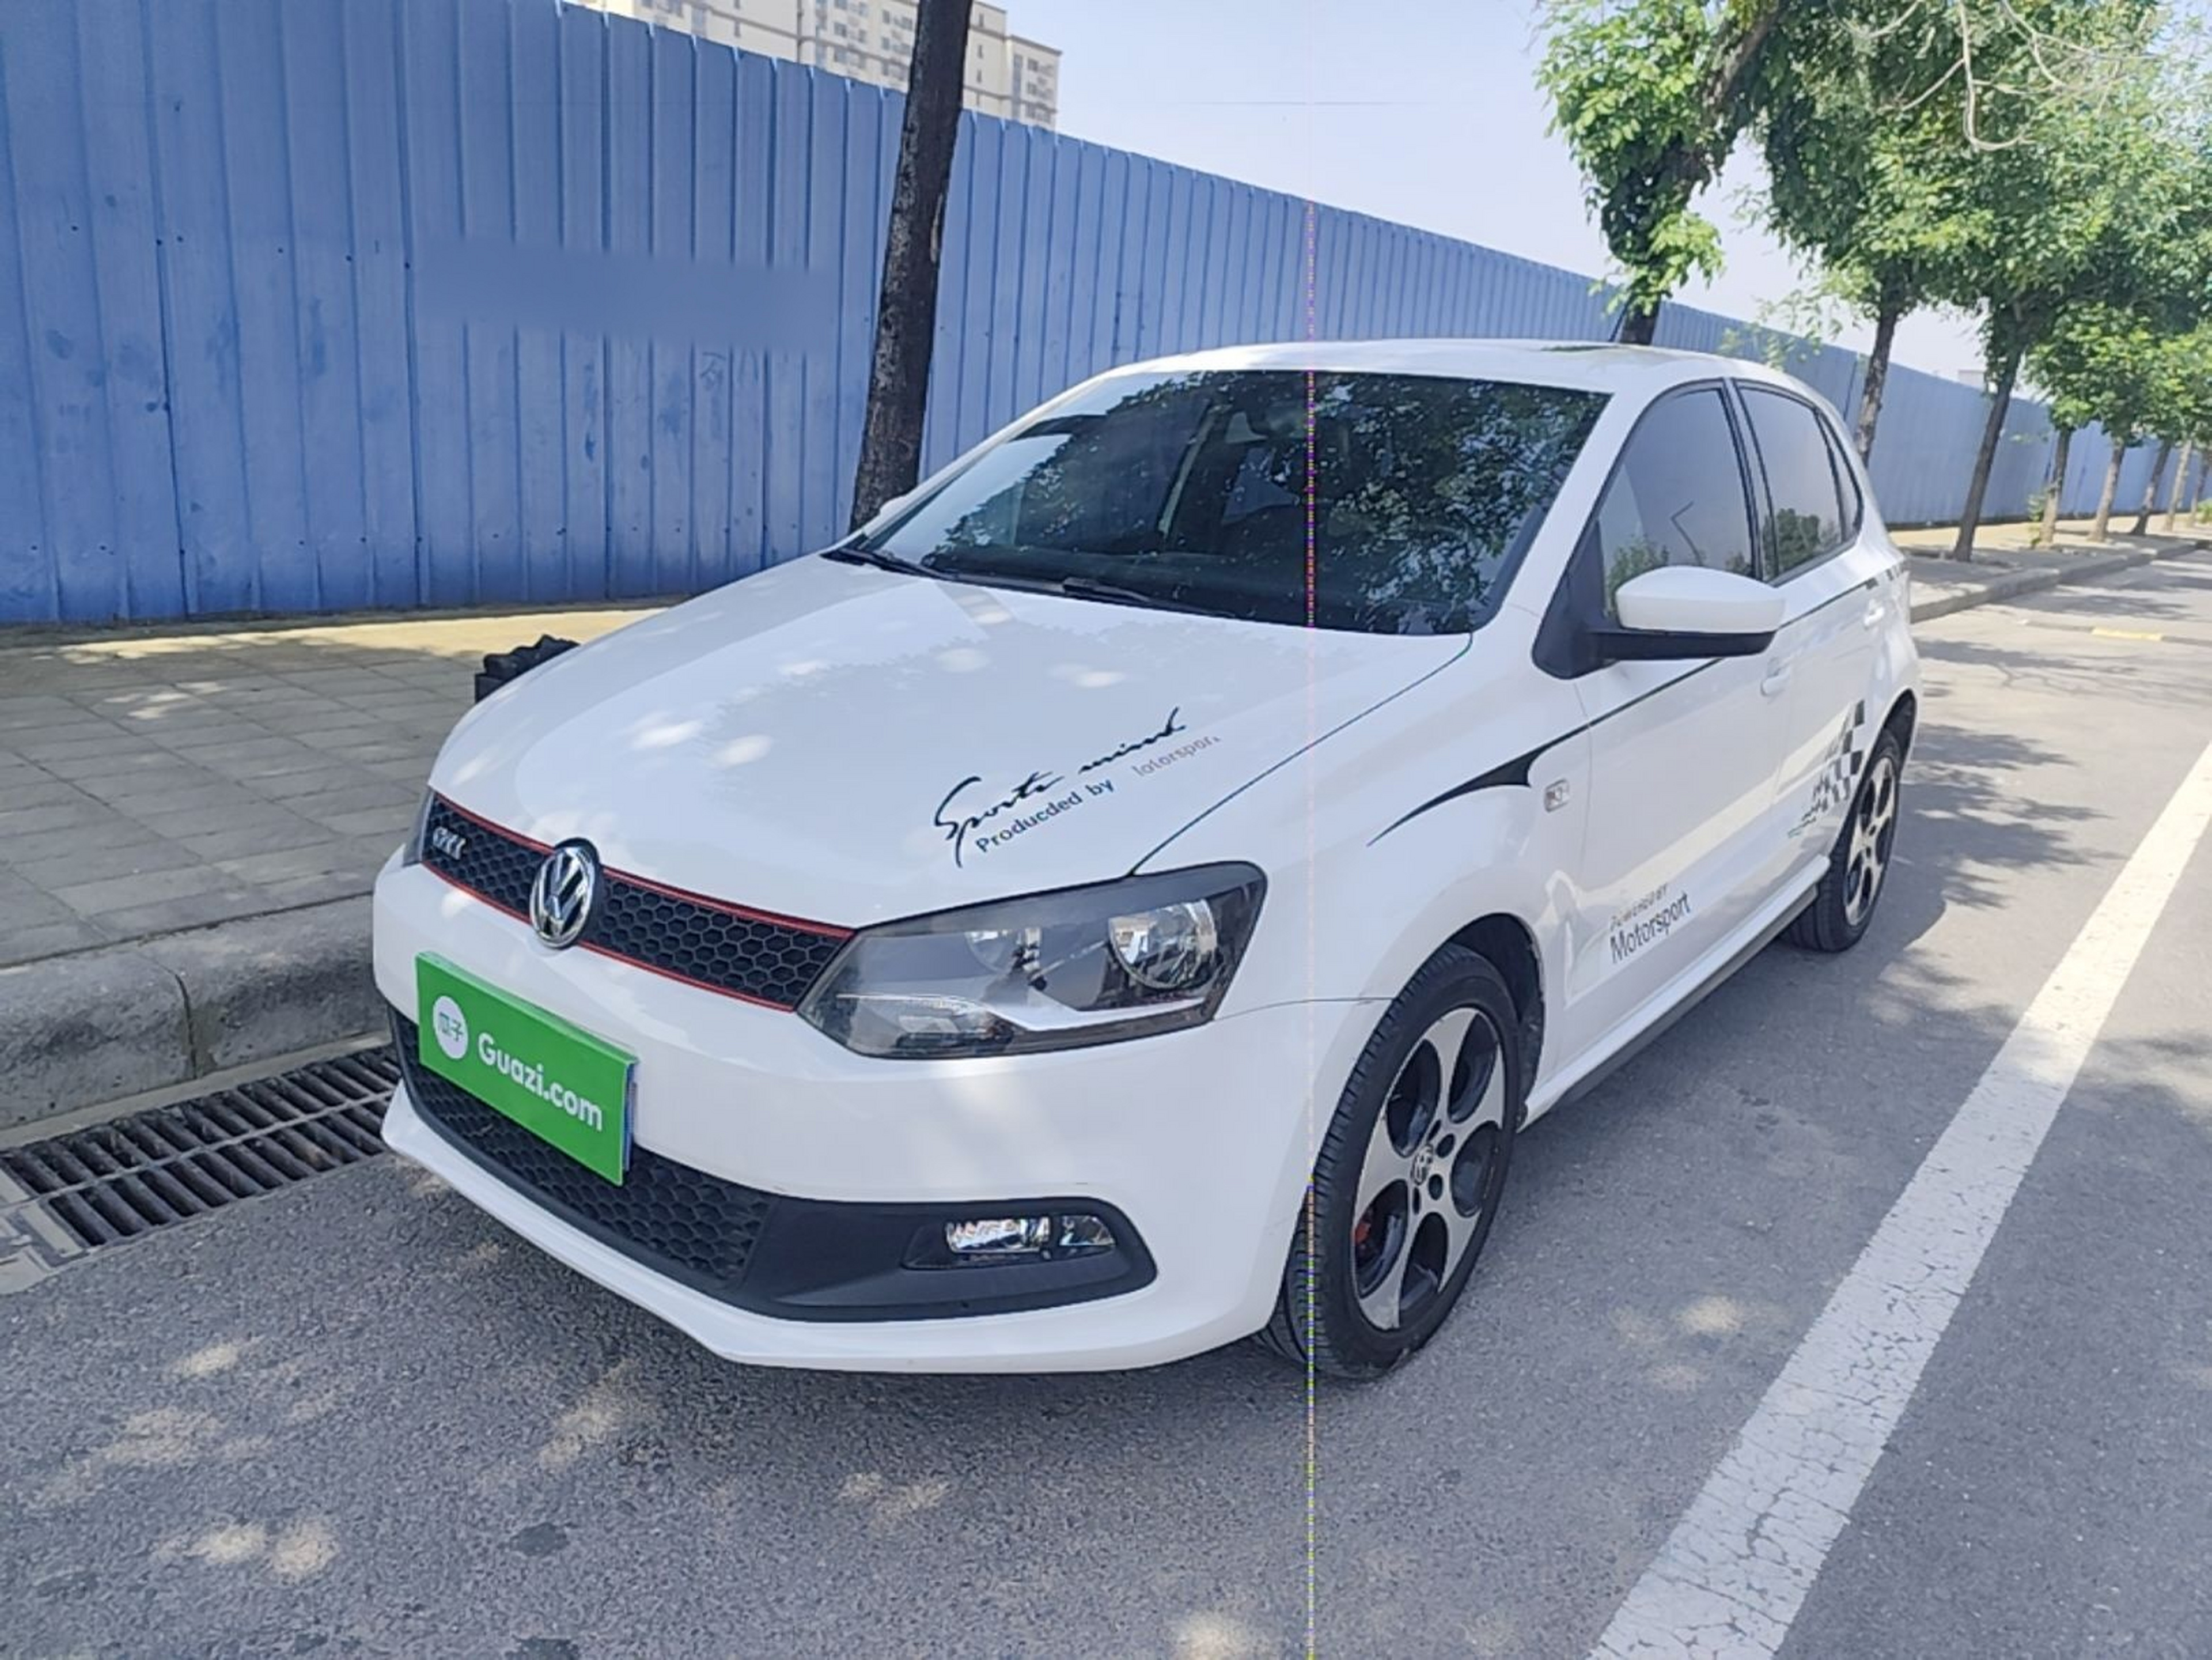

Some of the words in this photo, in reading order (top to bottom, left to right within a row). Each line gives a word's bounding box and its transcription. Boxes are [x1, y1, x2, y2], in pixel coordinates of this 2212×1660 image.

[975, 791, 1083, 853] Producded
[1085, 778, 1115, 796] by
[1610, 891, 1691, 965] Motorsport
[478, 1031, 603, 1133] Guazi.com
